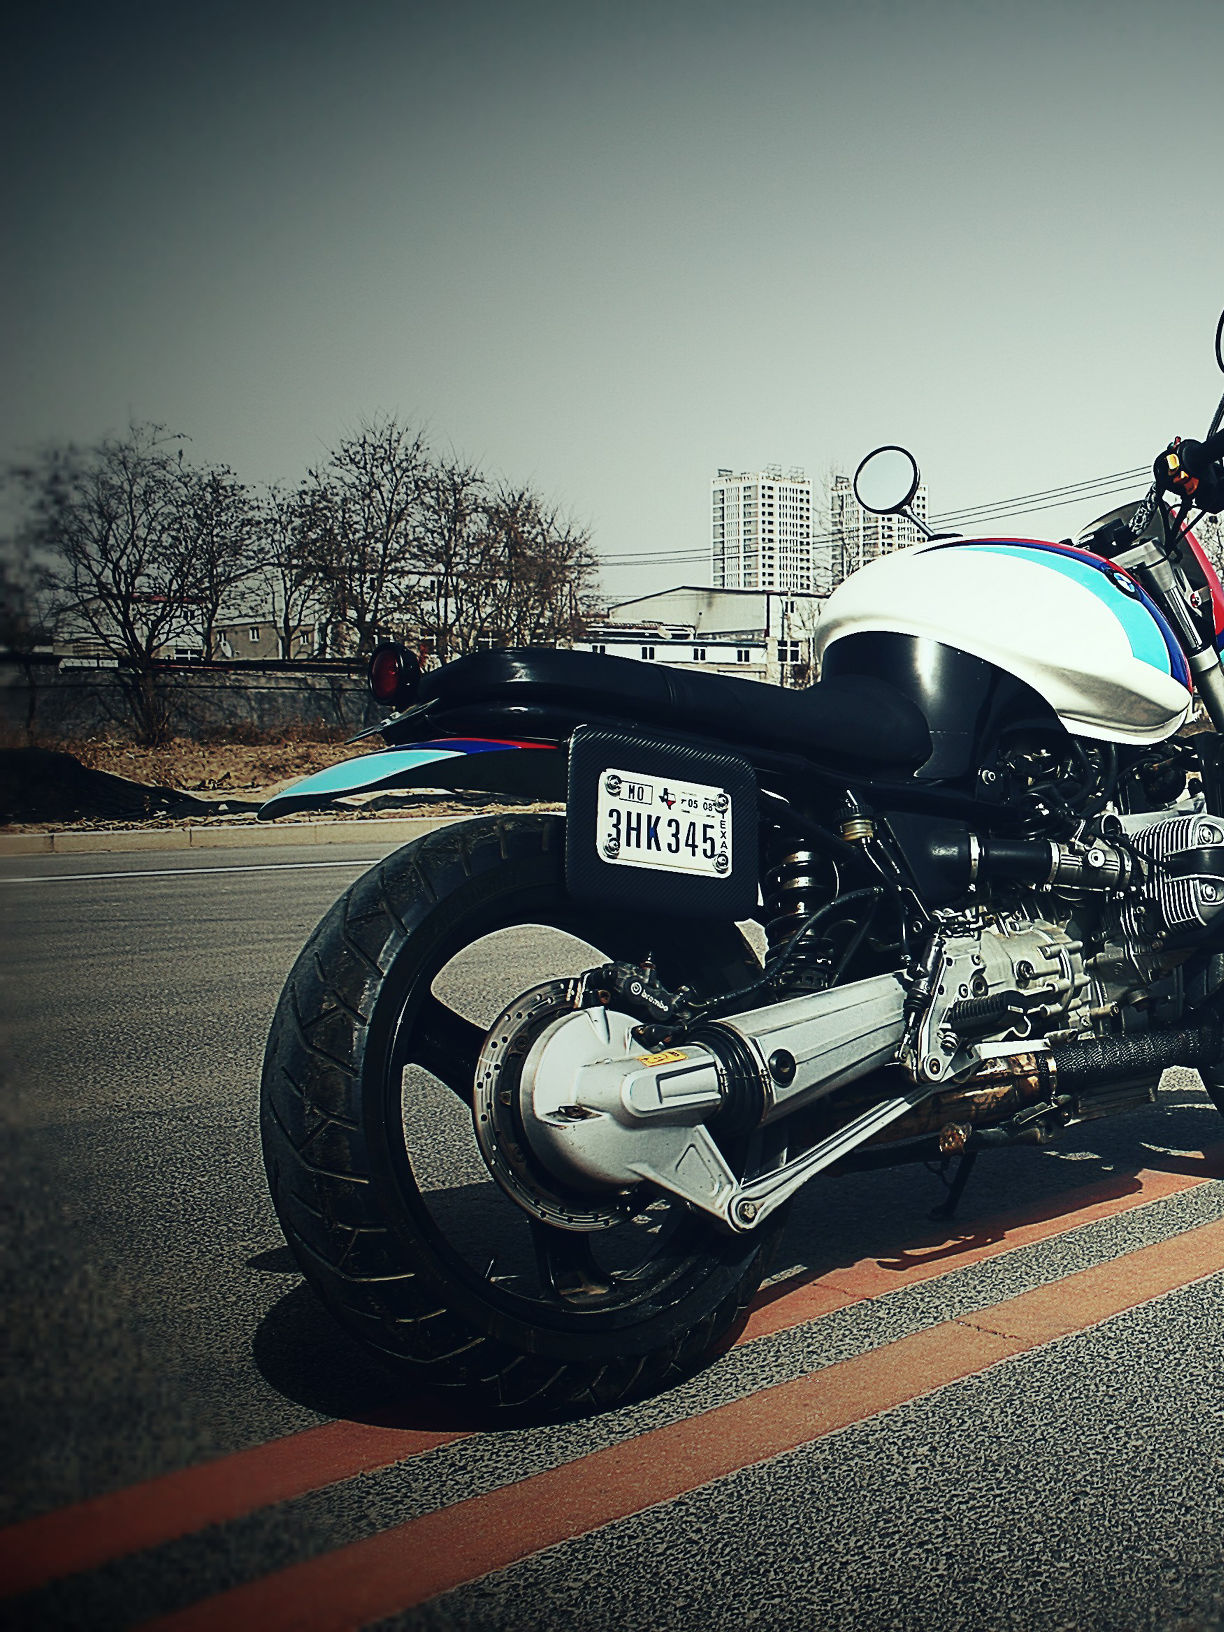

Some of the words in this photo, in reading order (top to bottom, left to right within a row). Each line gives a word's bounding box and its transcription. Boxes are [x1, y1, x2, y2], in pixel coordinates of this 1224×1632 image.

[687, 798, 699, 809] 05
[607, 808, 717, 860] 3HK345
[719, 811, 729, 854] TEXA
[641, 989, 669, 1012] brembo
